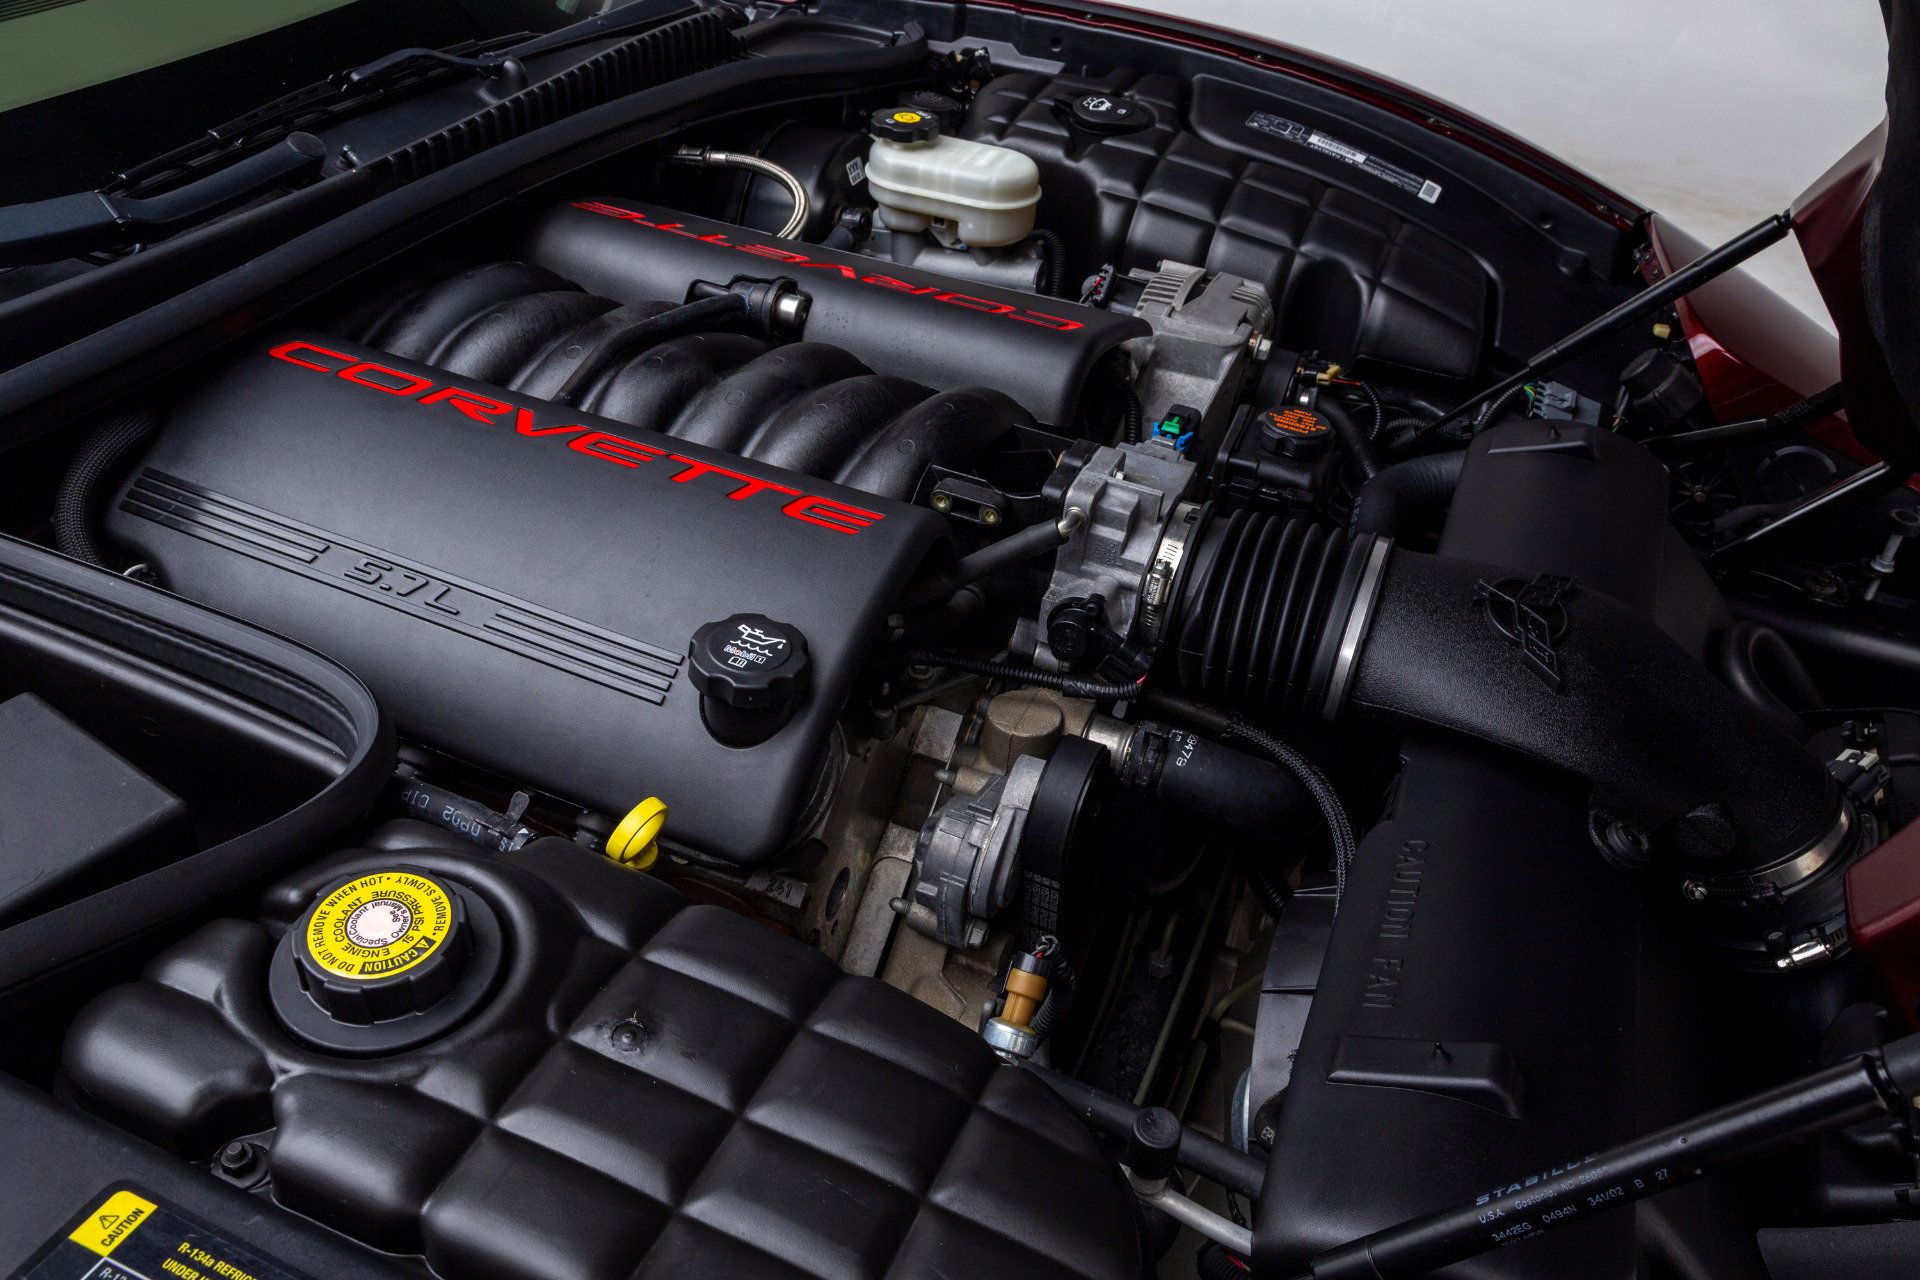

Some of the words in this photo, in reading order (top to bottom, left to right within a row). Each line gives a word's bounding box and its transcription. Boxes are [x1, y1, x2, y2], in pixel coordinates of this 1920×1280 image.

[569, 202, 1085, 331] CORVETTE
[268, 341, 886, 535] CORVETTE
[344, 557, 459, 615] 5.7L
[723, 645, 757, 661] Mobil
[360, 875, 384, 888] HOT
[395, 875, 437, 896] SLOWLY
[1380, 840, 1430, 938] CAUTION
[326, 884, 358, 907] WHEN
[371, 890, 422, 915] PRESSURE
[371, 900, 403, 912] Manual
[333, 896, 363, 943] COOLANT
[349, 906, 369, 935] Coolant
[389, 911, 401, 923] See
[391, 909, 410, 939] Owner's
[412, 916, 424, 931] PSI
[432, 895, 447, 932] REMOVE
[312, 909, 331, 949] REMOVE
[352, 934, 388, 945] Special
[402, 934, 415, 945] 15
[318, 949, 339, 965] NOT
[342, 942, 390, 958] ENGINE
[364, 949, 418, 972] CAUTION
[337, 960, 355, 972] DO
[1362, 957, 1405, 1008] FAN
[1479, 1208, 1506, 1225] U.S.A.
[1514, 1190, 1557, 1210] Gastonia,
[1560, 1180, 1575, 1192] NC
[1491, 1221, 1533, 1242] 3442EG
[1655, 1167, 1671, 1182] 27
[101, 1207, 145, 1247] CAUTION
[177, 1242, 215, 1267] R-134a
[98, 1267, 128, 1280] R-1
[162, 1257, 201, 1280] UNDER
